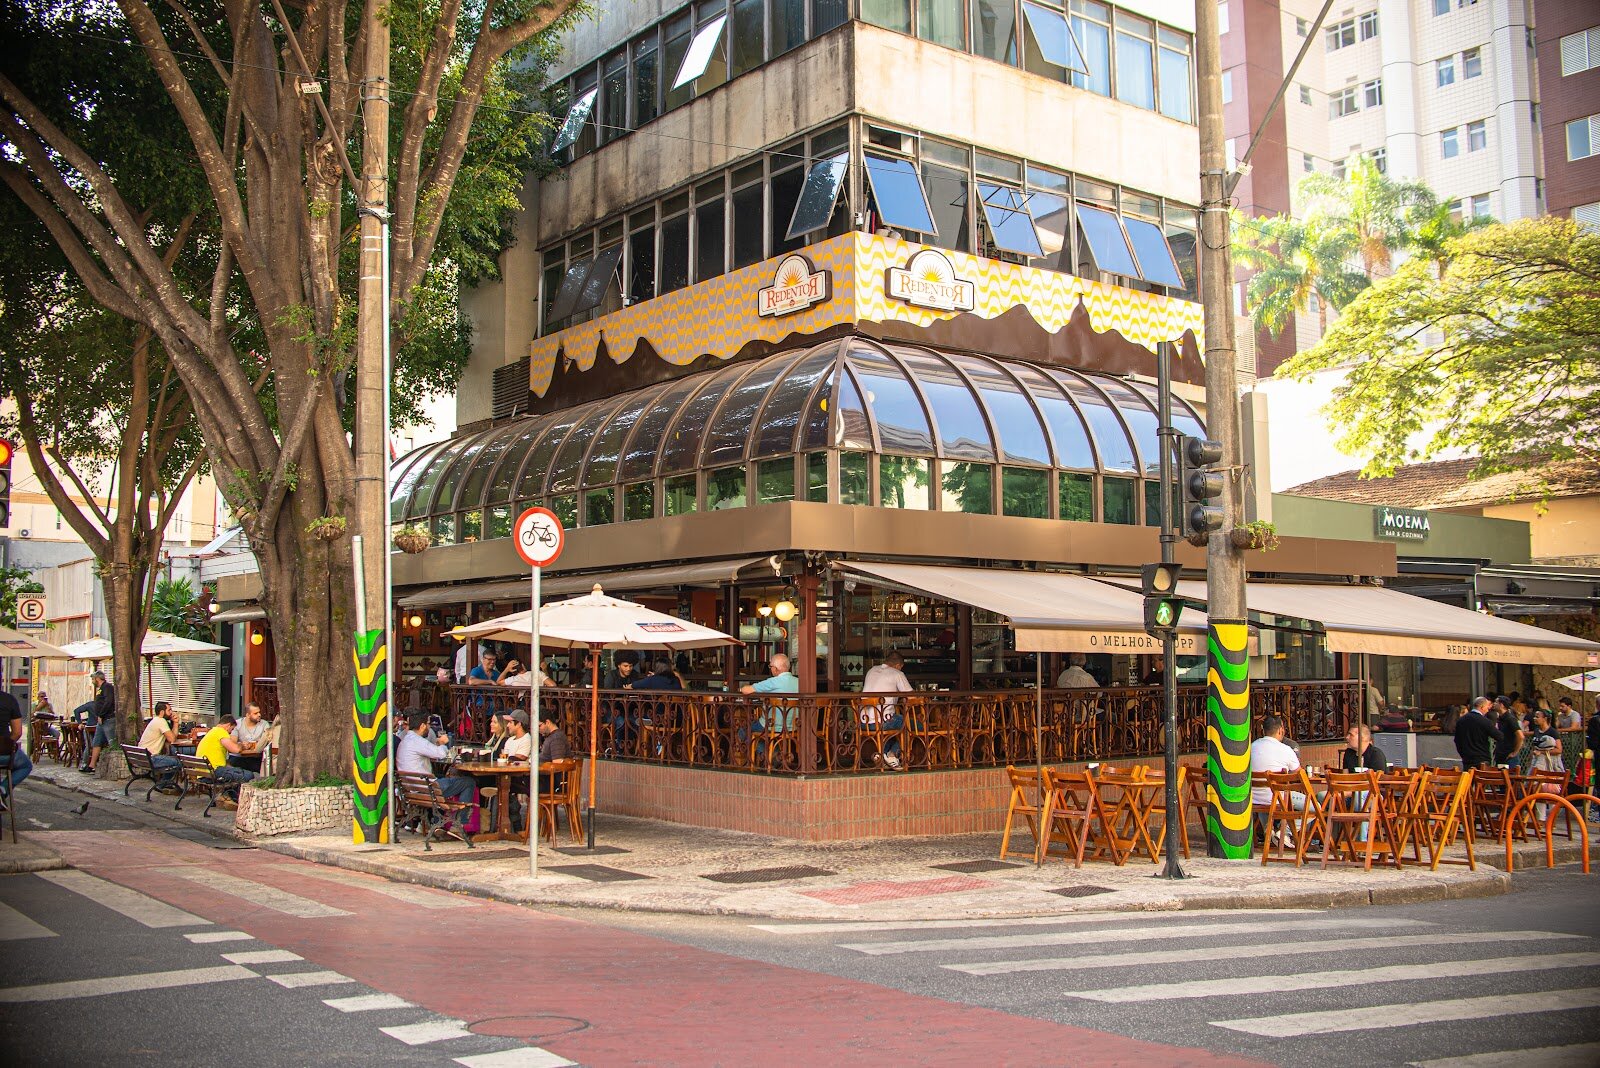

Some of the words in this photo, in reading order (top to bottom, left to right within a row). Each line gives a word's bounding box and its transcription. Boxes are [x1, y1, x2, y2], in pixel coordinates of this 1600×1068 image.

[766, 277, 819, 308] REDENTOR
[900, 274, 964, 303] REDENTOR
[1383, 512, 1430, 530] MOEMA
[27, 603, 37, 617] E
[1090, 635, 1098, 646] O
[1103, 635, 1153, 648] MELHOR
[1157, 637, 1194, 649] COPP
[1446, 644, 1489, 656] REDENTOR
